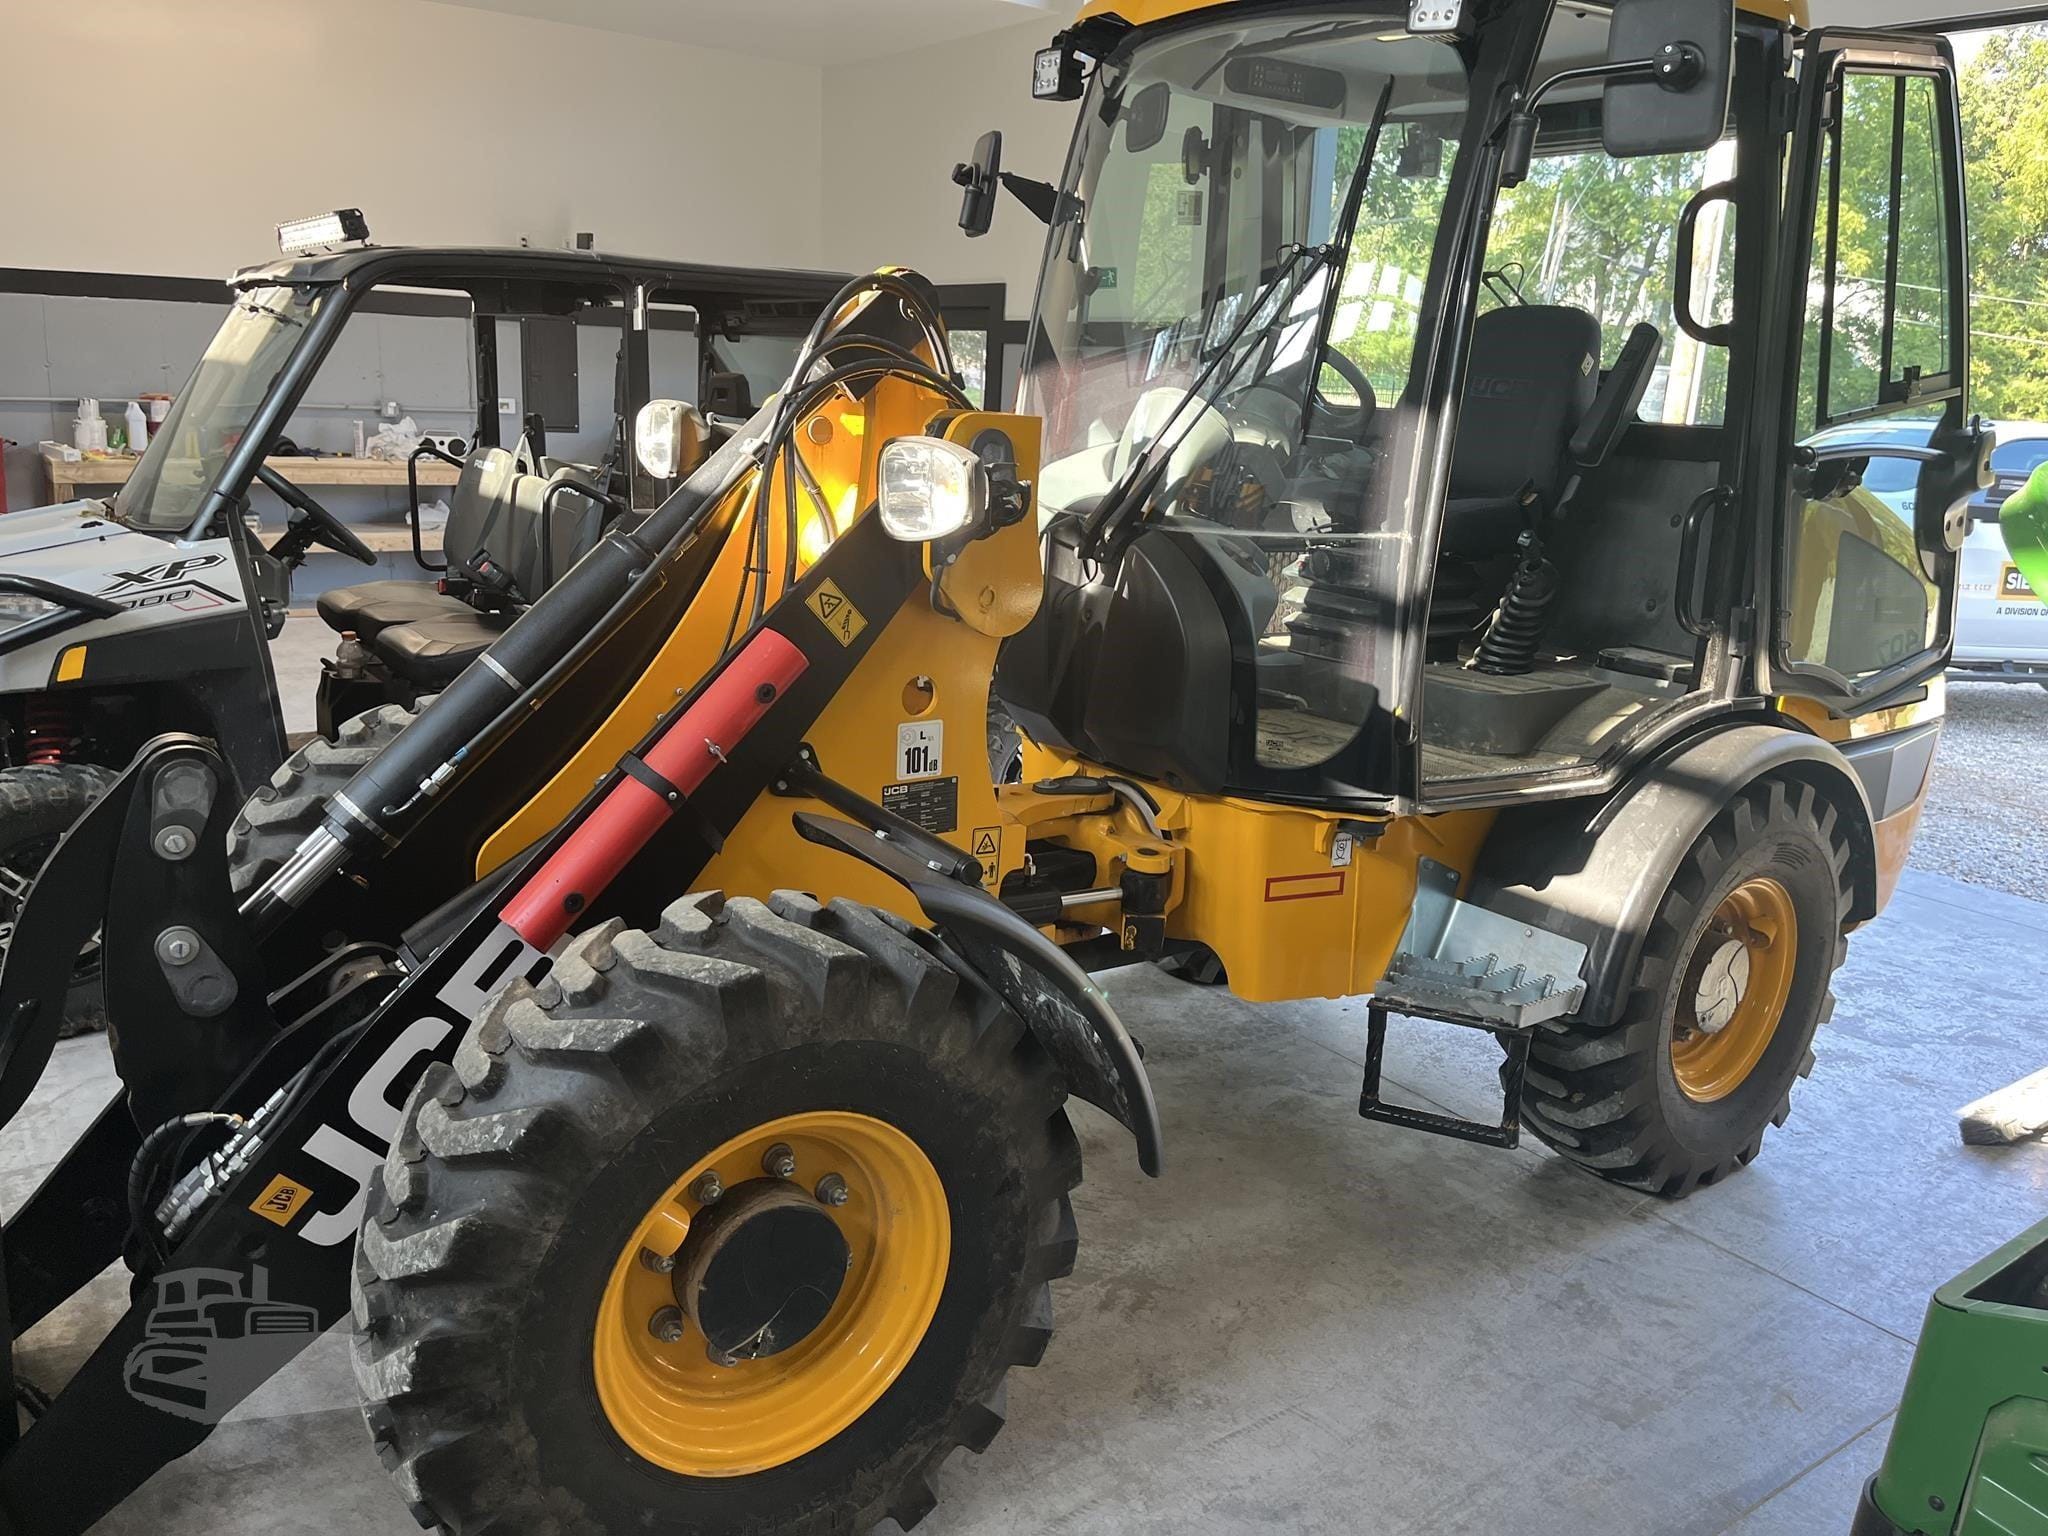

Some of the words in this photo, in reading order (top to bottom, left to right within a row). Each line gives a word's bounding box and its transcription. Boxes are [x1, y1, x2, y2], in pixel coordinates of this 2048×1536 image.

[97, 553, 227, 596] XP
[1996, 606, 2003, 615] A
[2004, 606, 2039, 617] DIVISION
[920, 731, 927, 740] L
[884, 785, 908, 796] JCB
[266, 1188, 295, 1211] JCB
